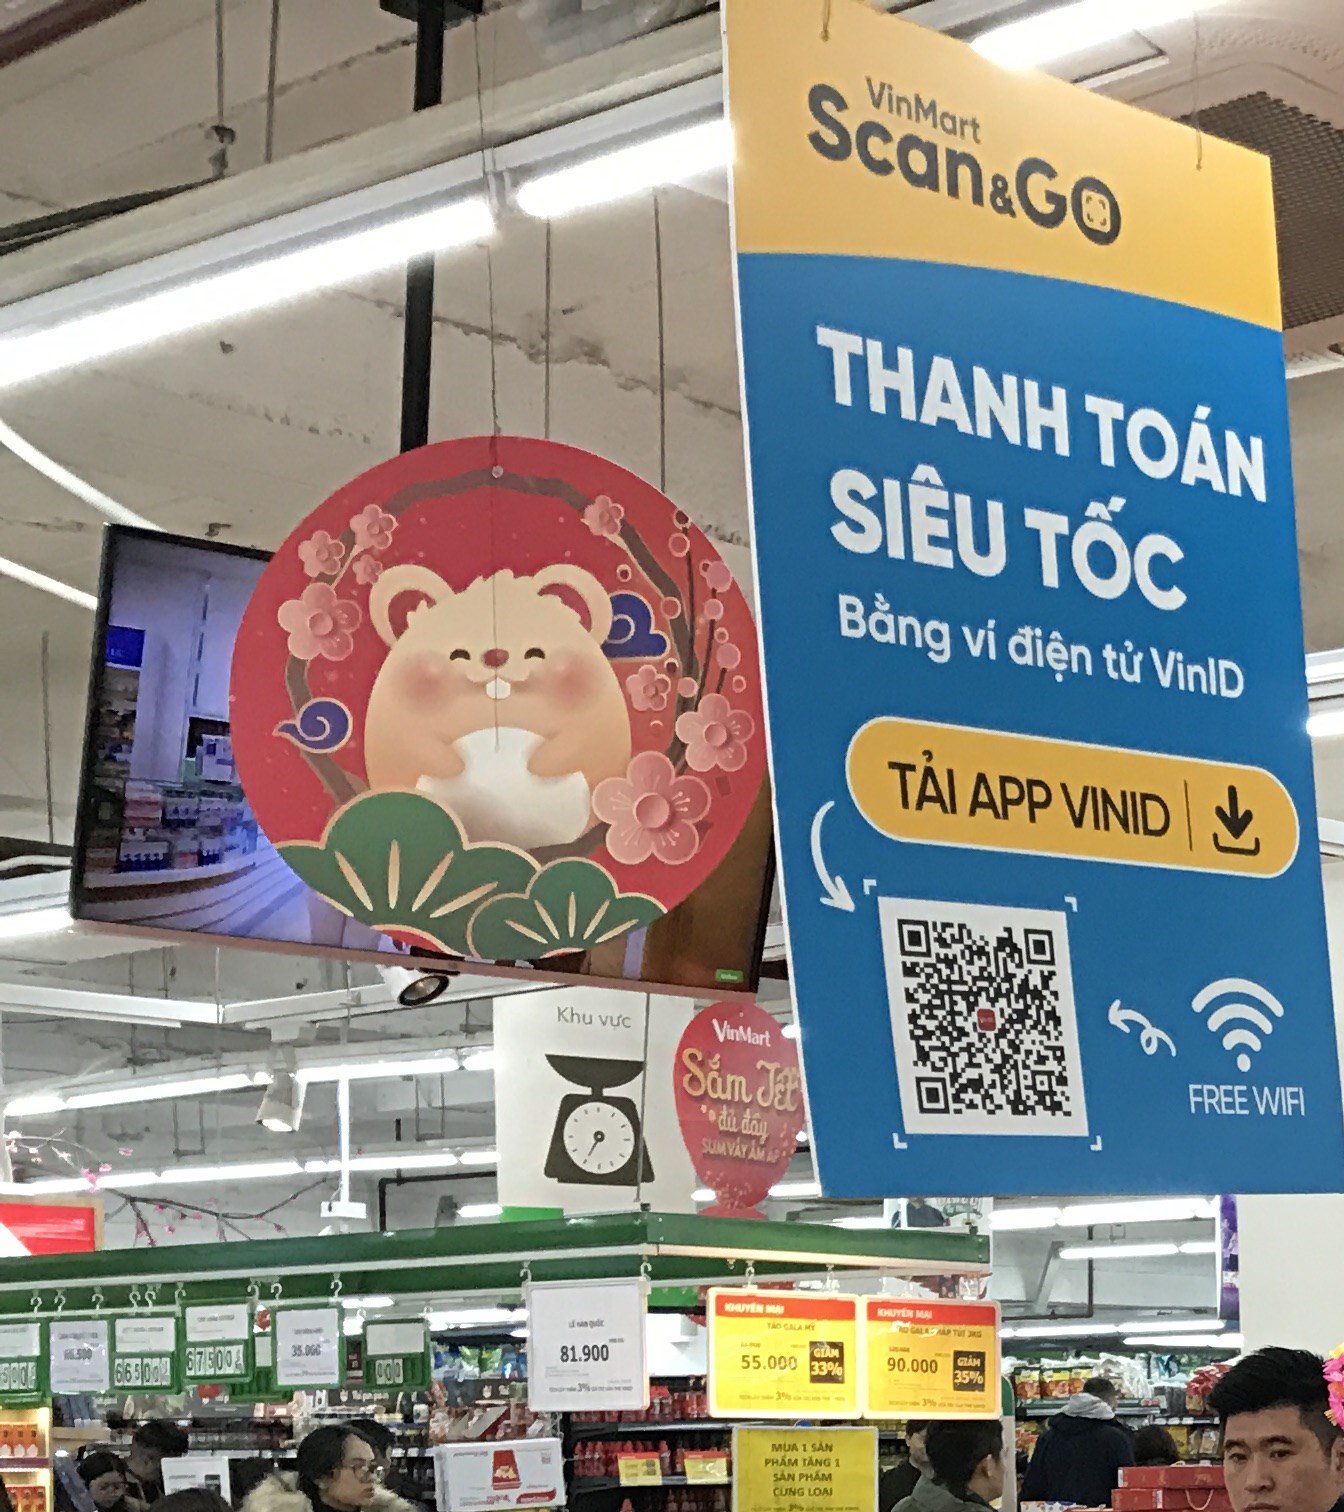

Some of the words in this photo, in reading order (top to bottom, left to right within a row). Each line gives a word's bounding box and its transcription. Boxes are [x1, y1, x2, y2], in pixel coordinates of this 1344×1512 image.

[866, 76, 981, 144] VinMart
[816, 324, 1070, 458] THANH
[1084, 394, 1267, 502] TOÁN
[829, 464, 1003, 577] SIÊU
[1024, 496, 1187, 611] TỐC
[838, 593, 952, 663] Bằng
[962, 617, 997, 662] ví
[1008, 624, 1094, 682] điện
[1103, 641, 1142, 684] tử
[1154, 646, 1245, 699] VinID
[888, 750, 957, 815] TẢI
[968, 776, 1052, 823] APP
[1063, 785, 1170, 838] VINID
[557, 1007, 593, 1027] Khu
[600, 1012, 632, 1030] vực
[712, 1018, 771, 1047] VinMart
[682, 1048, 753, 1103] Sắm
[1189, 1083, 1248, 1116] FREE
[1254, 1085, 1305, 1116] WIFI
[725, 1302, 763, 1314] KHUYẾN
[766, 1304, 784, 1315] MẠI
[877, 1308, 913, 1318] KHUYẾN
[916, 1310, 932, 1320] MẠI
[784, 1323, 802, 1331] GALA
[560, 1344, 609, 1362] 81.900
[814, 1345, 839, 1358] GIẢM
[741, 1355, 797, 1370] 55.000
[811, 1361, 842, 1376] 33%
[888, 1358, 938, 1373] 90.000
[957, 1355, 980, 1367] GIẢM
[954, 1371, 983, 1384] 35%
[771, 1443, 798, 1452] MUA
[802, 1444, 807, 1452] 1
[811, 1441, 833, 1452] SẢN
[765, 1455, 798, 1467] PHẨM
[835, 1458, 840, 1467] 1
[773, 1471, 795, 1482] SẢN
[798, 1470, 832, 1482] PHẨM
